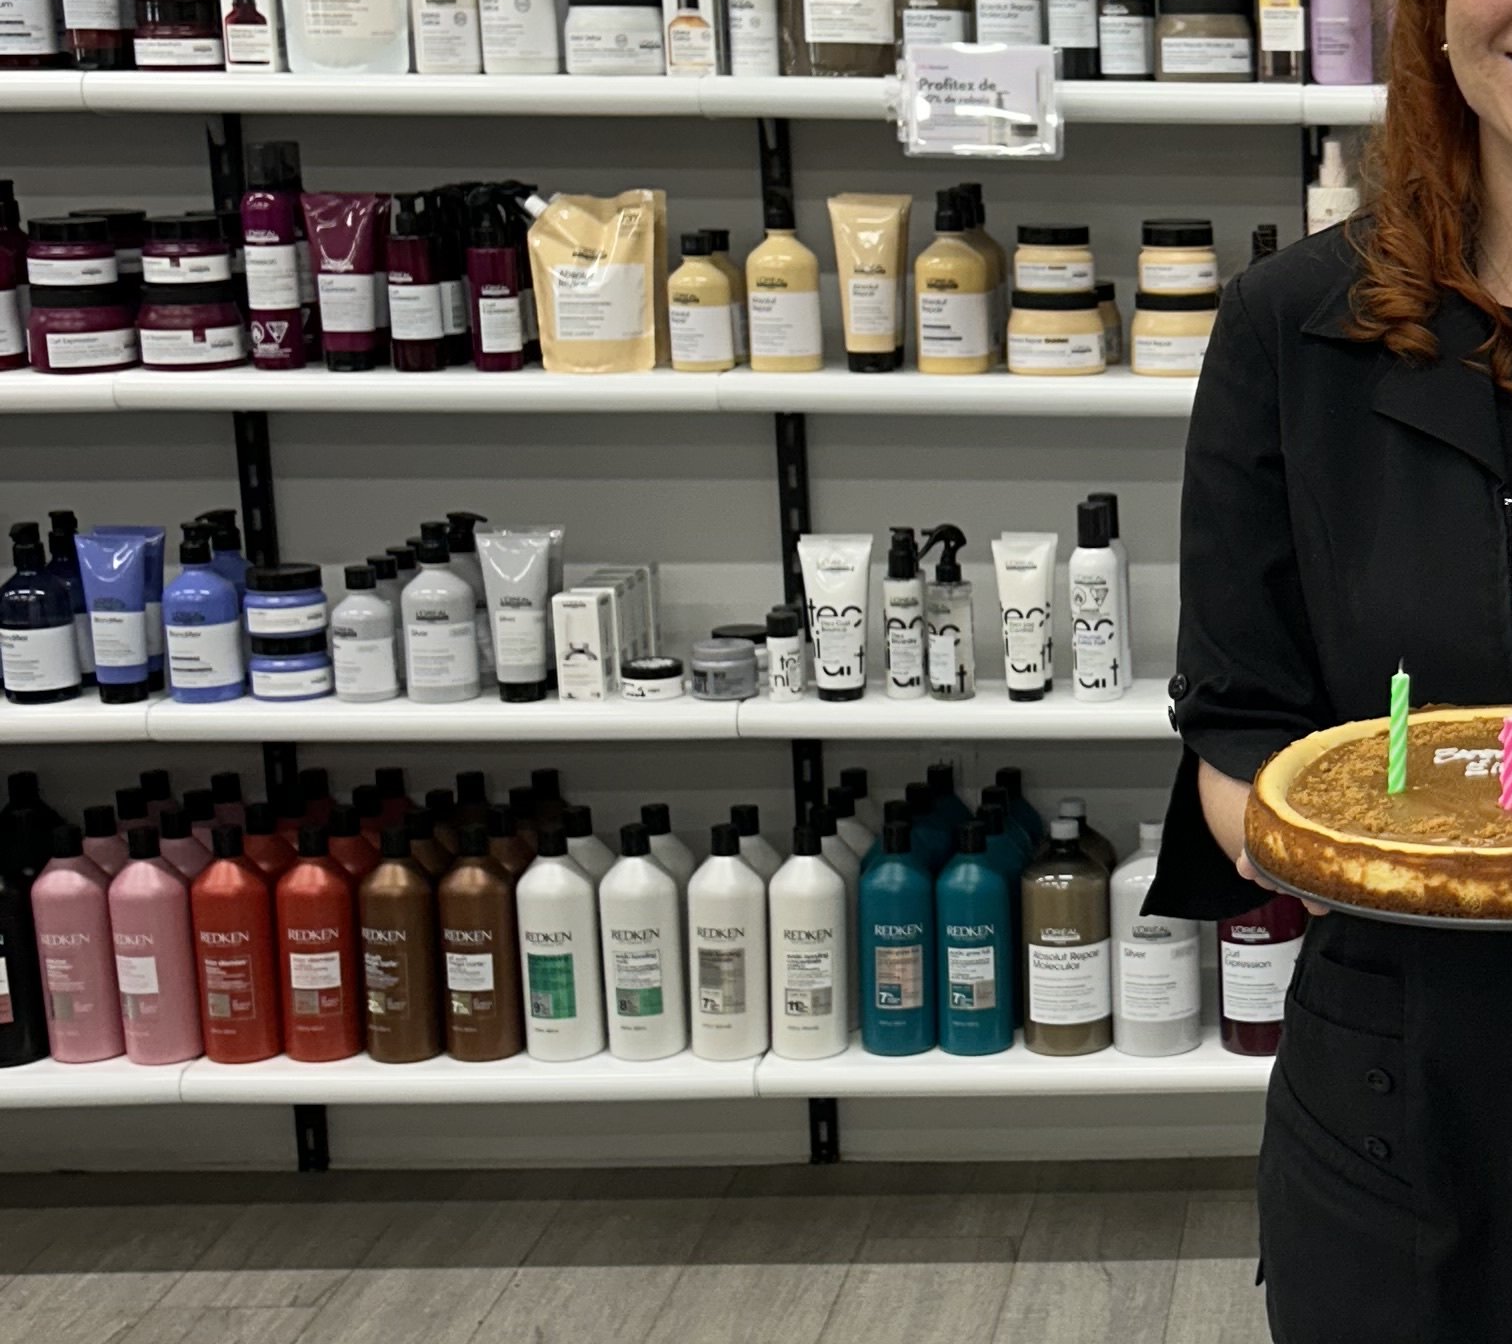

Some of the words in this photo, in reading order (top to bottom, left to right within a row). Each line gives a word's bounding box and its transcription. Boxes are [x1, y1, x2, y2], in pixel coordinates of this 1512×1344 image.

[979, 78, 996, 91] de
[288, 927, 339, 941] REDKEN
[362, 928, 406, 941] REDKEN
[444, 929, 492, 942] REDKEN
[611, 928, 660, 941] REDKEN
[697, 926, 745, 938] REDKEN
[784, 928, 833, 942] REDKEN
[874, 923, 923, 936] REDKEN
[946, 924, 994, 937] REDKEN
[41, 933, 90, 946] REDKEN
[200, 930, 250, 944] REDKEN
[525, 930, 573, 943] REDKEN
